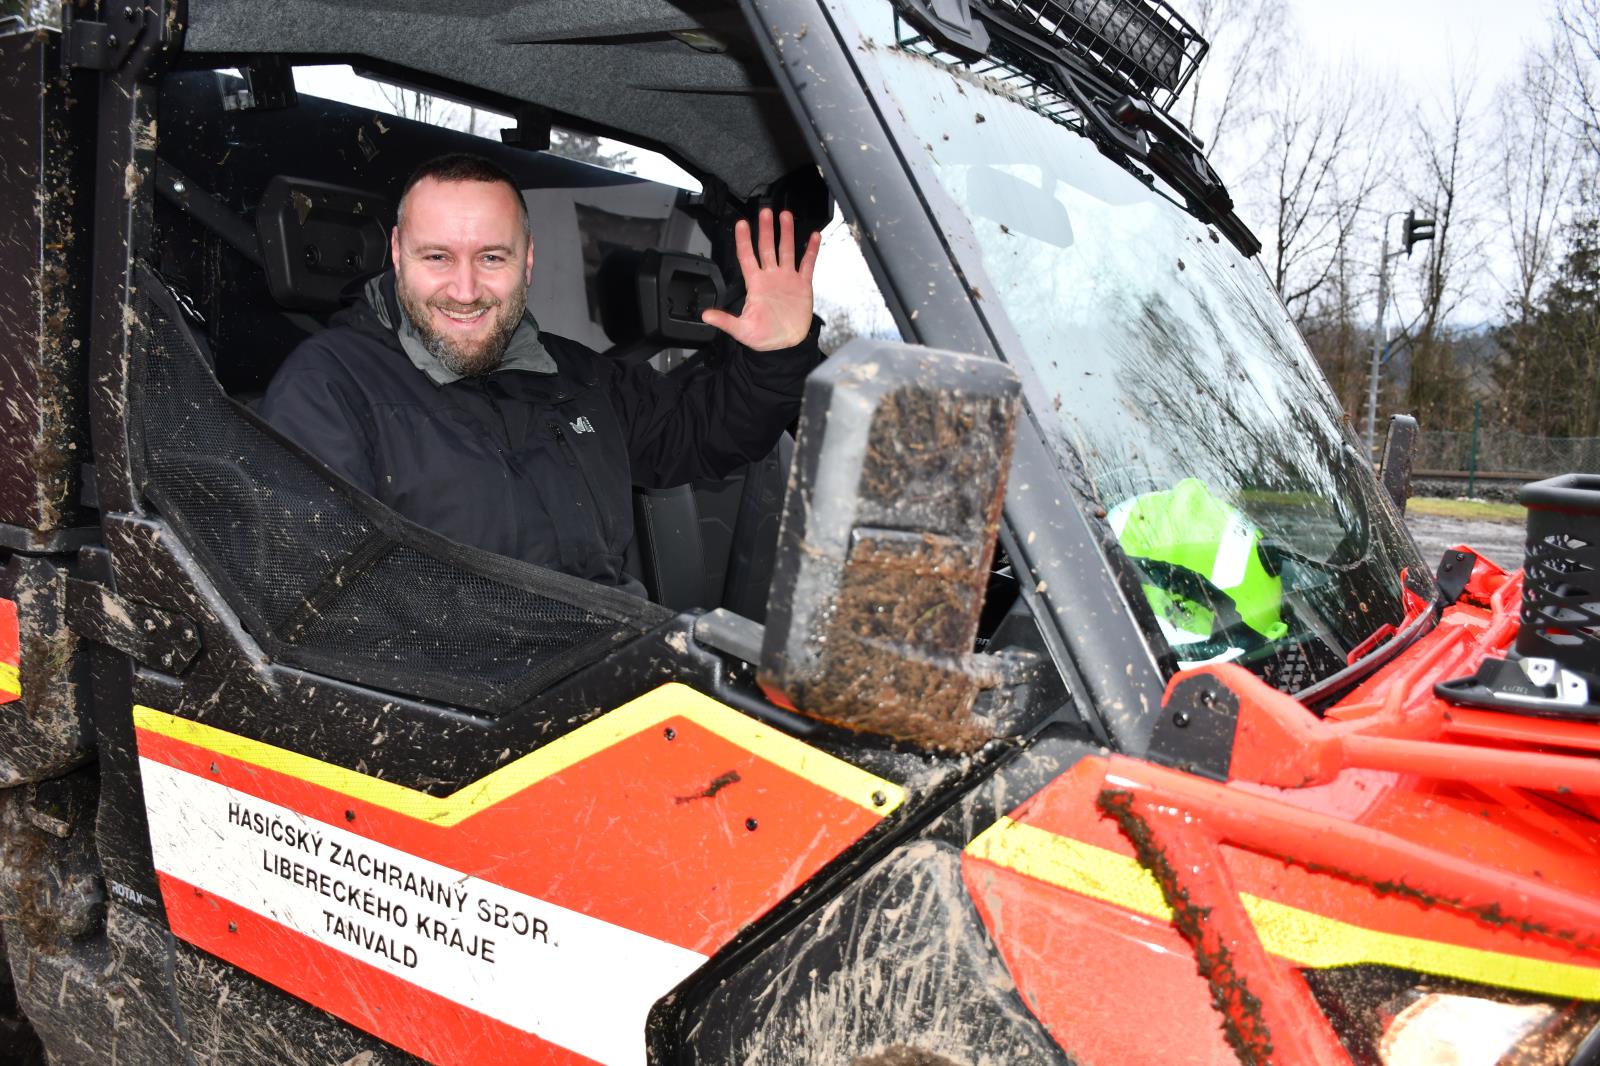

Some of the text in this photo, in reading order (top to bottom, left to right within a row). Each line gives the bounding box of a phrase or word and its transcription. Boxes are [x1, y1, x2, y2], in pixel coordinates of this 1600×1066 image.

[111, 880, 143, 905] ROTAX
[228, 803, 323, 857] HASIČSKÝ
[329, 841, 467, 913] ZACHRANNÝ
[262, 850, 497, 964] LIBERECKÉHO KRAJE
[321, 911, 418, 969] TANVALD
